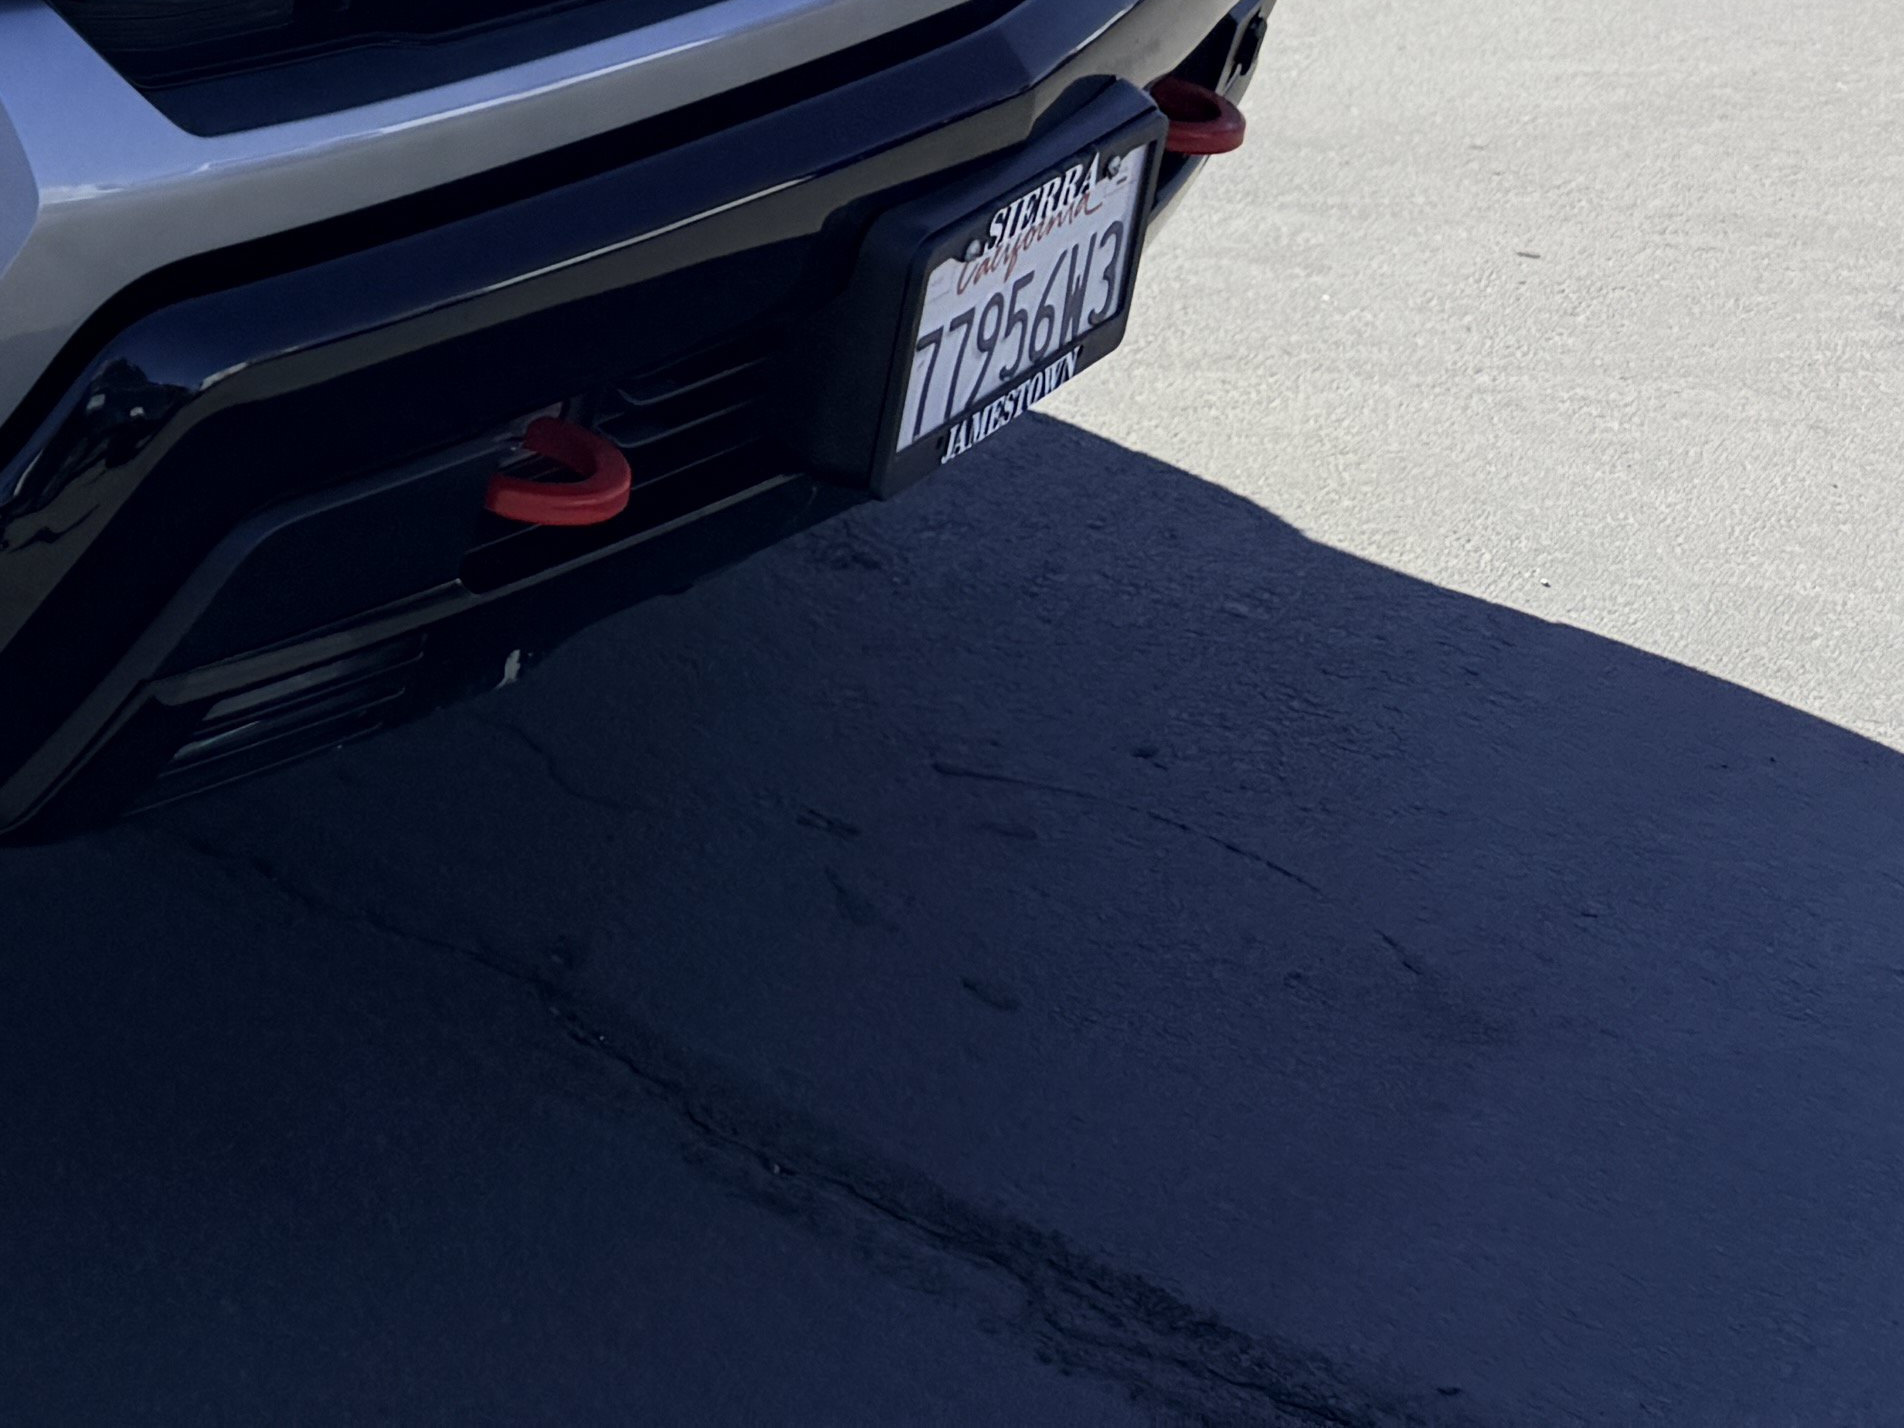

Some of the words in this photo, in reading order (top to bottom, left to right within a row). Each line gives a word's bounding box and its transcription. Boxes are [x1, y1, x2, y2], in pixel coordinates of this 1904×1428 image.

[984, 151, 1101, 250] SIERRA
[912, 220, 1124, 443] 77956W3
[940, 344, 1086, 465] JAMESTOWN
